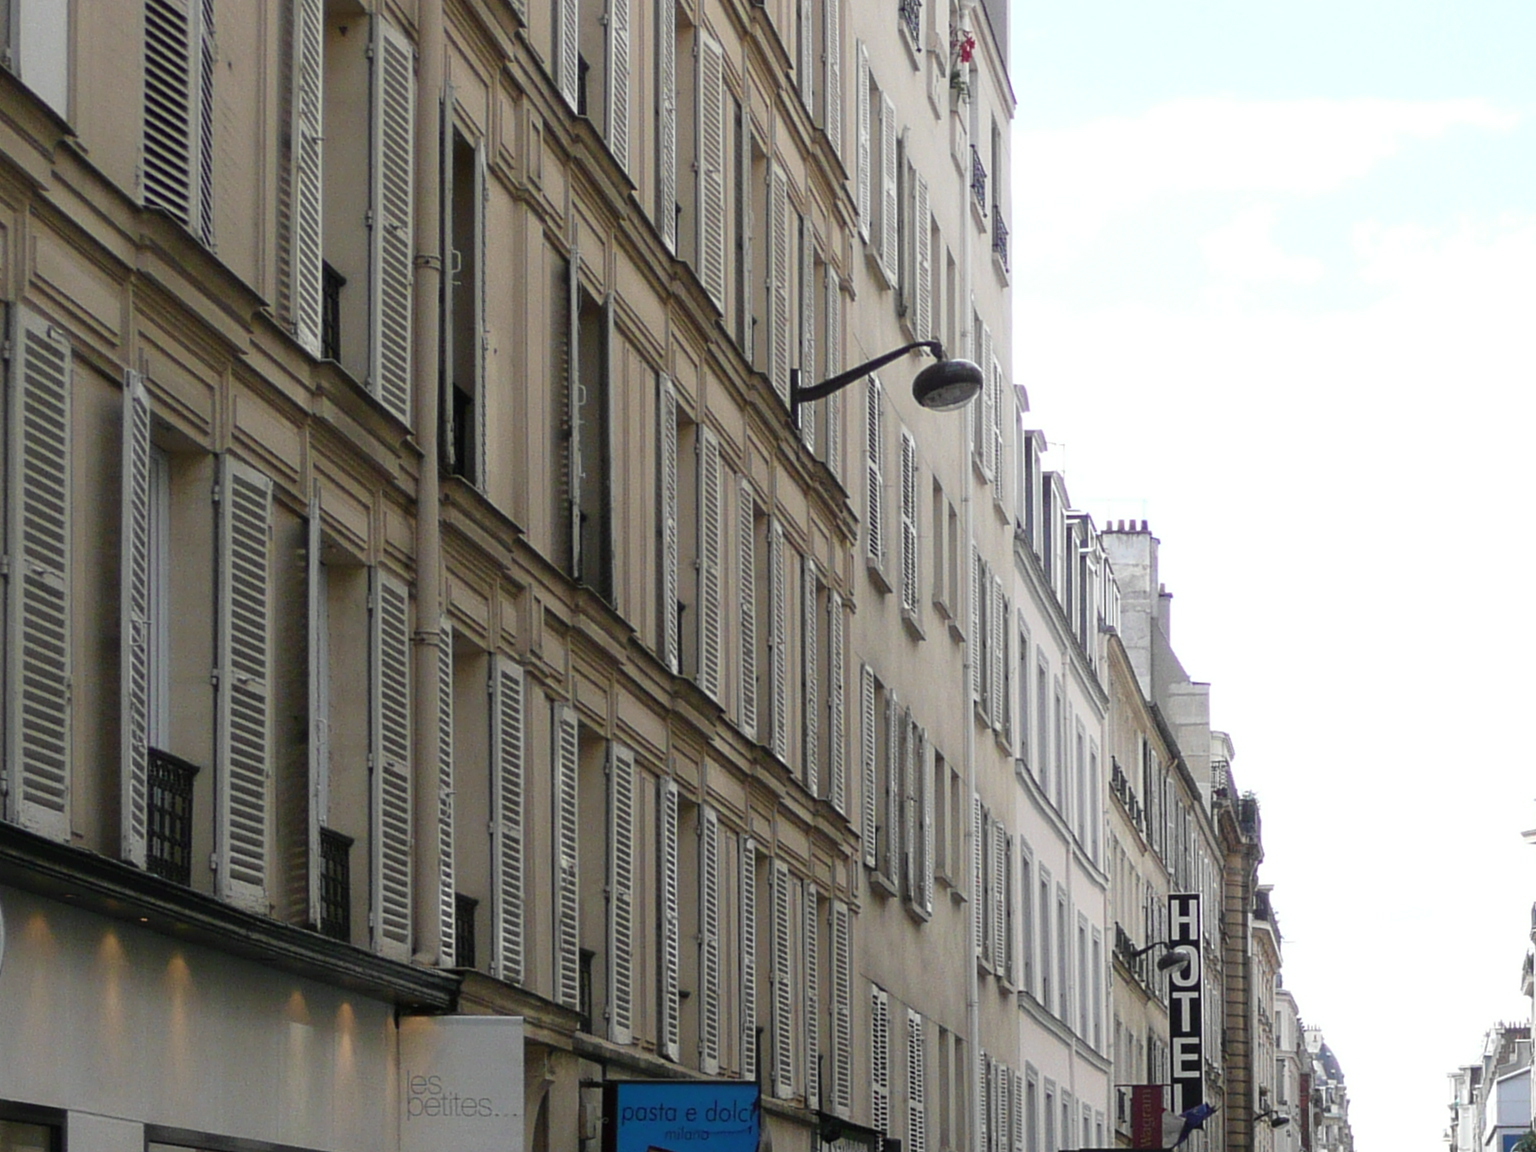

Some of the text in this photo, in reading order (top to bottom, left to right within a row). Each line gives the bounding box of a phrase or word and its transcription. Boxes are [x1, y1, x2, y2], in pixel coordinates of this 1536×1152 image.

[407, 1070, 442, 1095] les
[622, 1102, 678, 1126] pasta
[686, 1107, 698, 1122] e
[665, 1126, 710, 1141] milano
